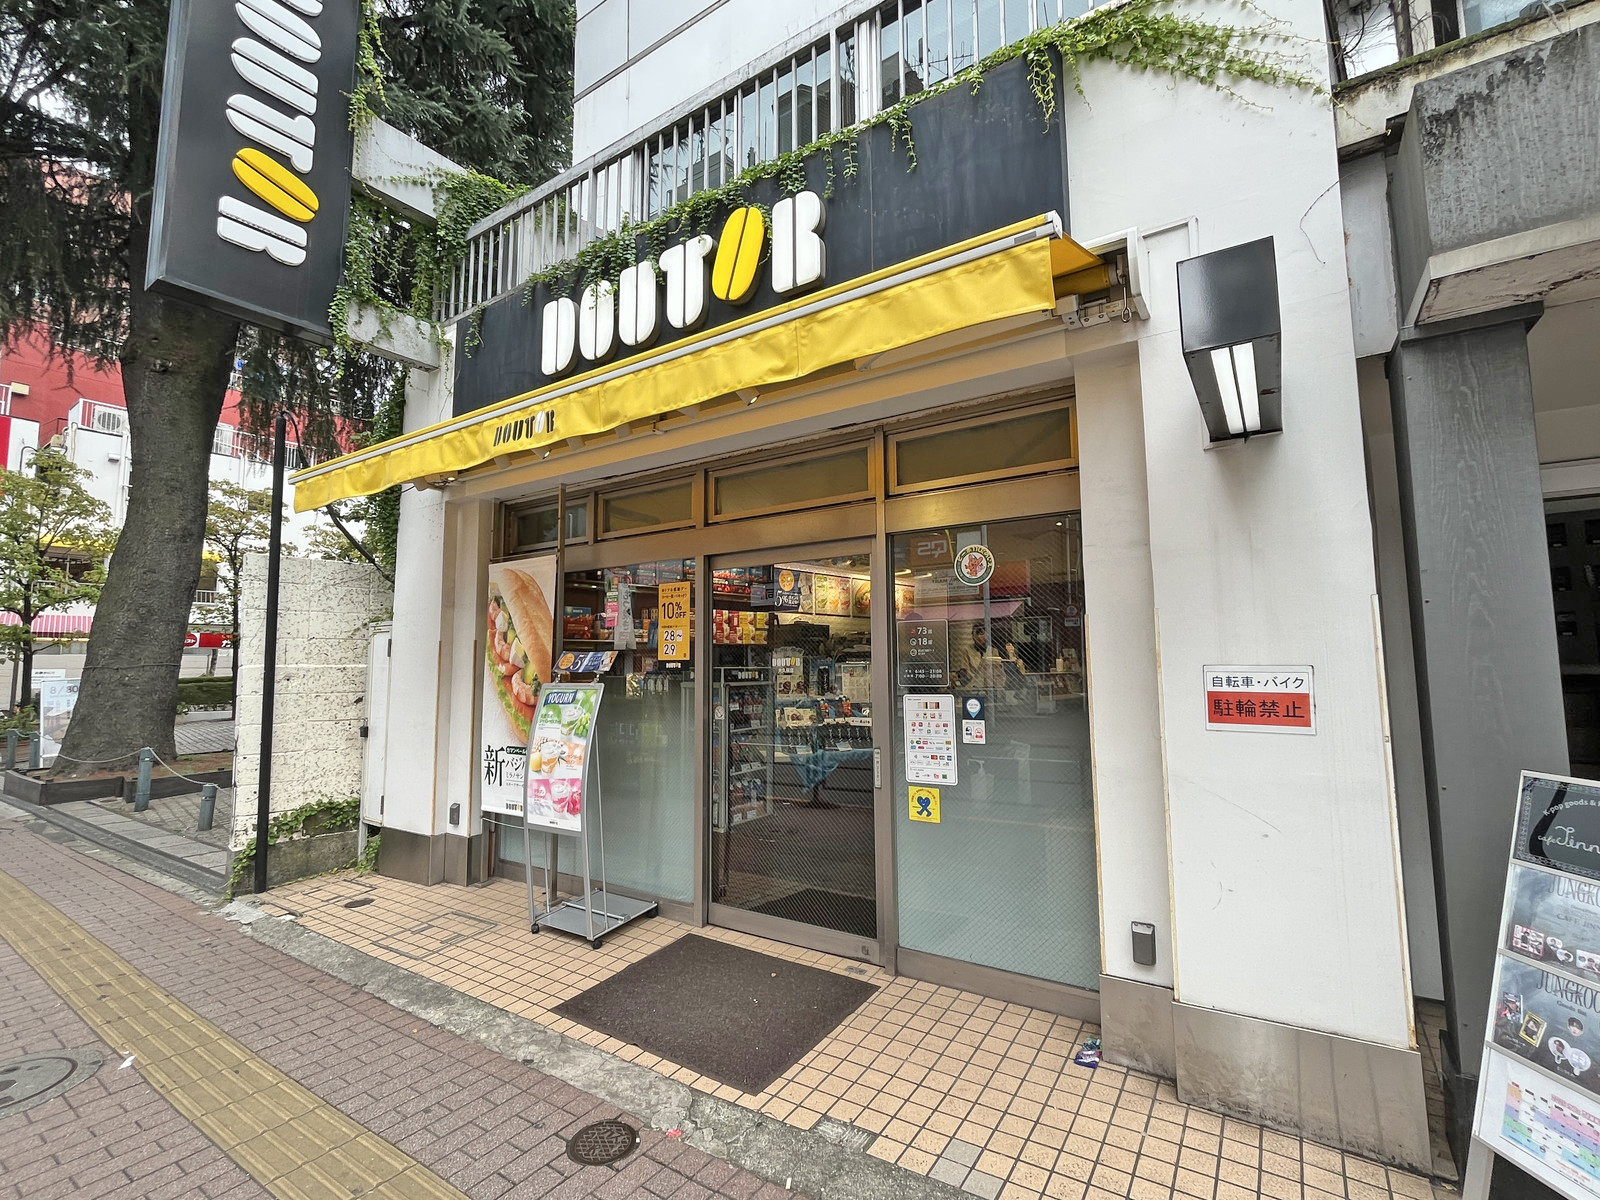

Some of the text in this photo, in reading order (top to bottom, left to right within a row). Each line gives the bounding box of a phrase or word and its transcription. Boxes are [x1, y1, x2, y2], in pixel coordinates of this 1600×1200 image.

[541, 190, 824, 377] DOUTOR
[493, 409, 555, 447] DOUTOR
[674, 611, 687, 619] OFF
[663, 644, 676, 655] 29
[772, 656, 801, 667] DOUTOR
[1212, 675, 1305, 689] 自転車・バイク
[547, 692, 576, 704] YOGURN
[1213, 698, 1305, 718] 駐輪禁止
[484, 744, 506, 787] 新
[1564, 798, 1588, 809] goods
